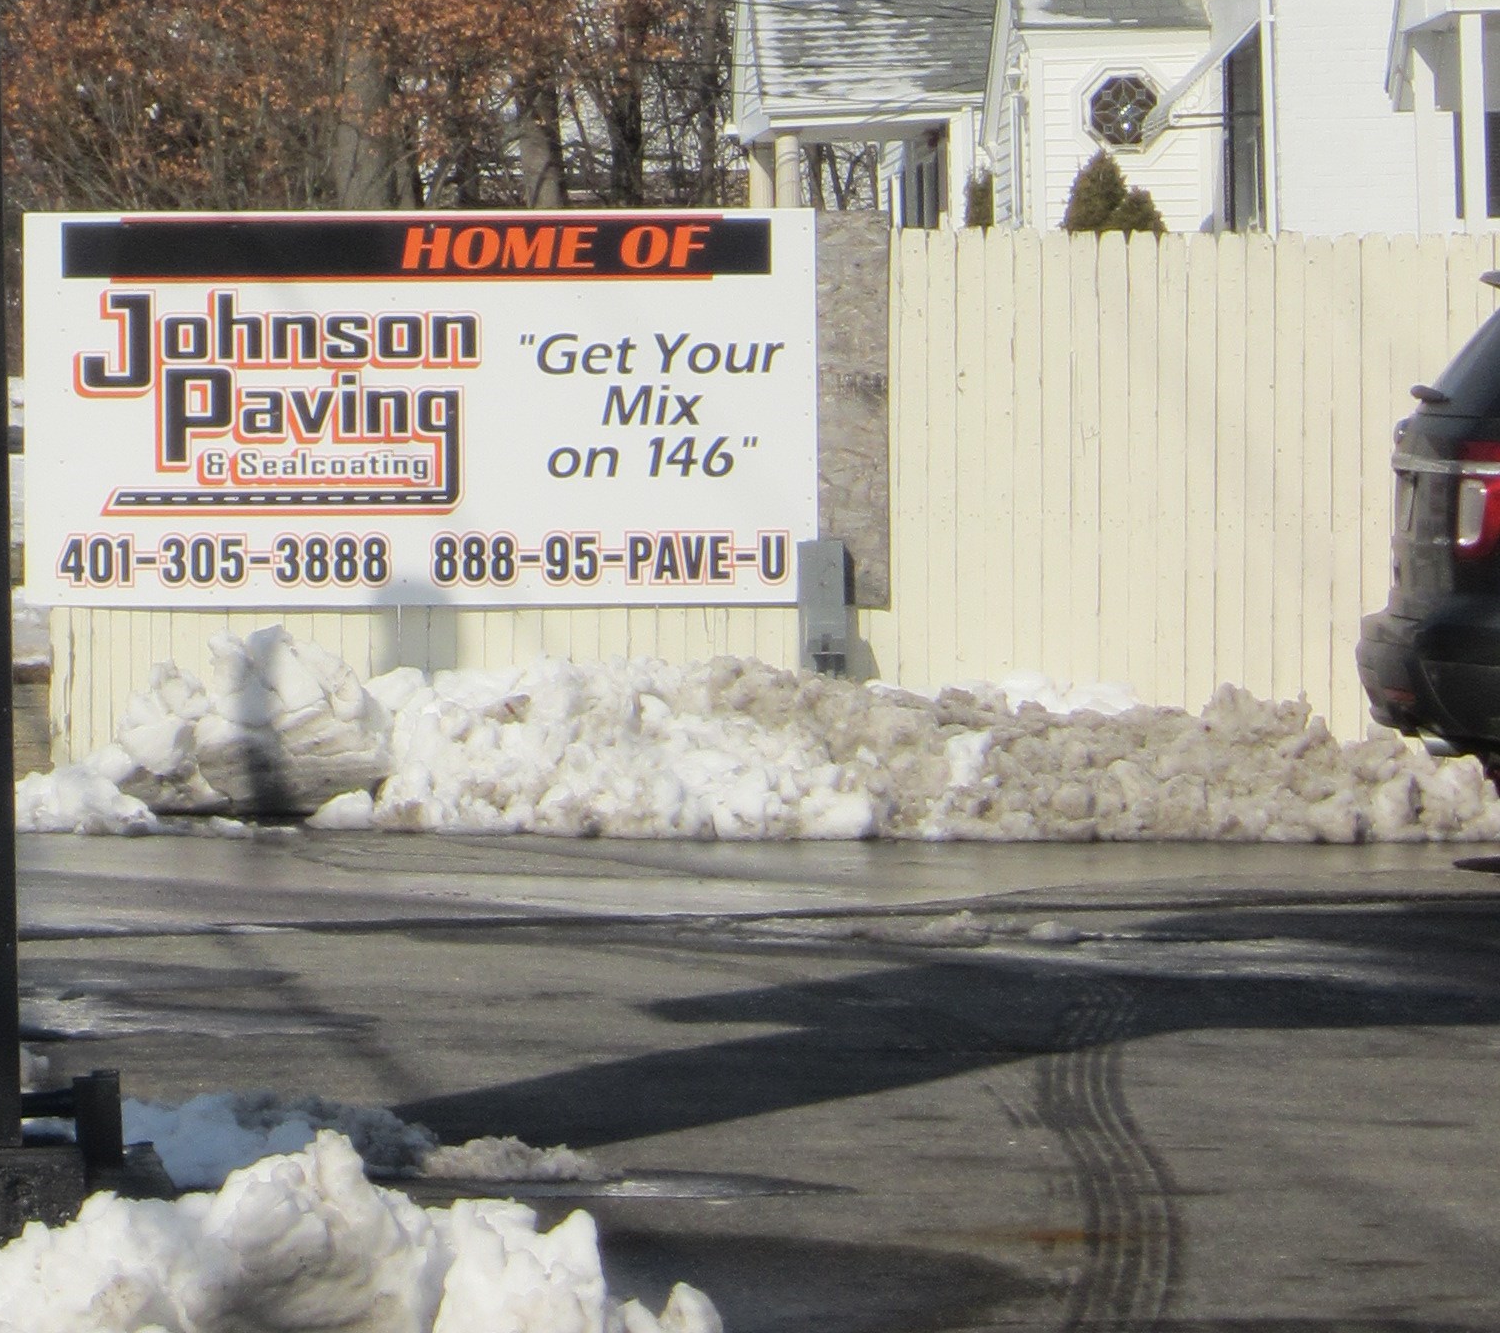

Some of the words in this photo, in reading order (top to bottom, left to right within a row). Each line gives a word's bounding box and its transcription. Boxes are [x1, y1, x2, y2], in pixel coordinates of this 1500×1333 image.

[401, 226, 598, 271] HOME
[618, 224, 713, 270] OF
[77, 290, 479, 393] Johnson
[519, 333, 633, 375] "Get
[654, 332, 786, 375] Your
[601, 384, 703, 427] Mix
[159, 370, 462, 491] Paving
[205, 452, 226, 477] &
[238, 451, 430, 482] Sealcoating
[547, 445, 620, 479] on
[647, 435, 759, 478] 146"
[59, 536, 390, 584] 401-305-3888
[432, 533, 789, 583] 888-95-PAVE-U
